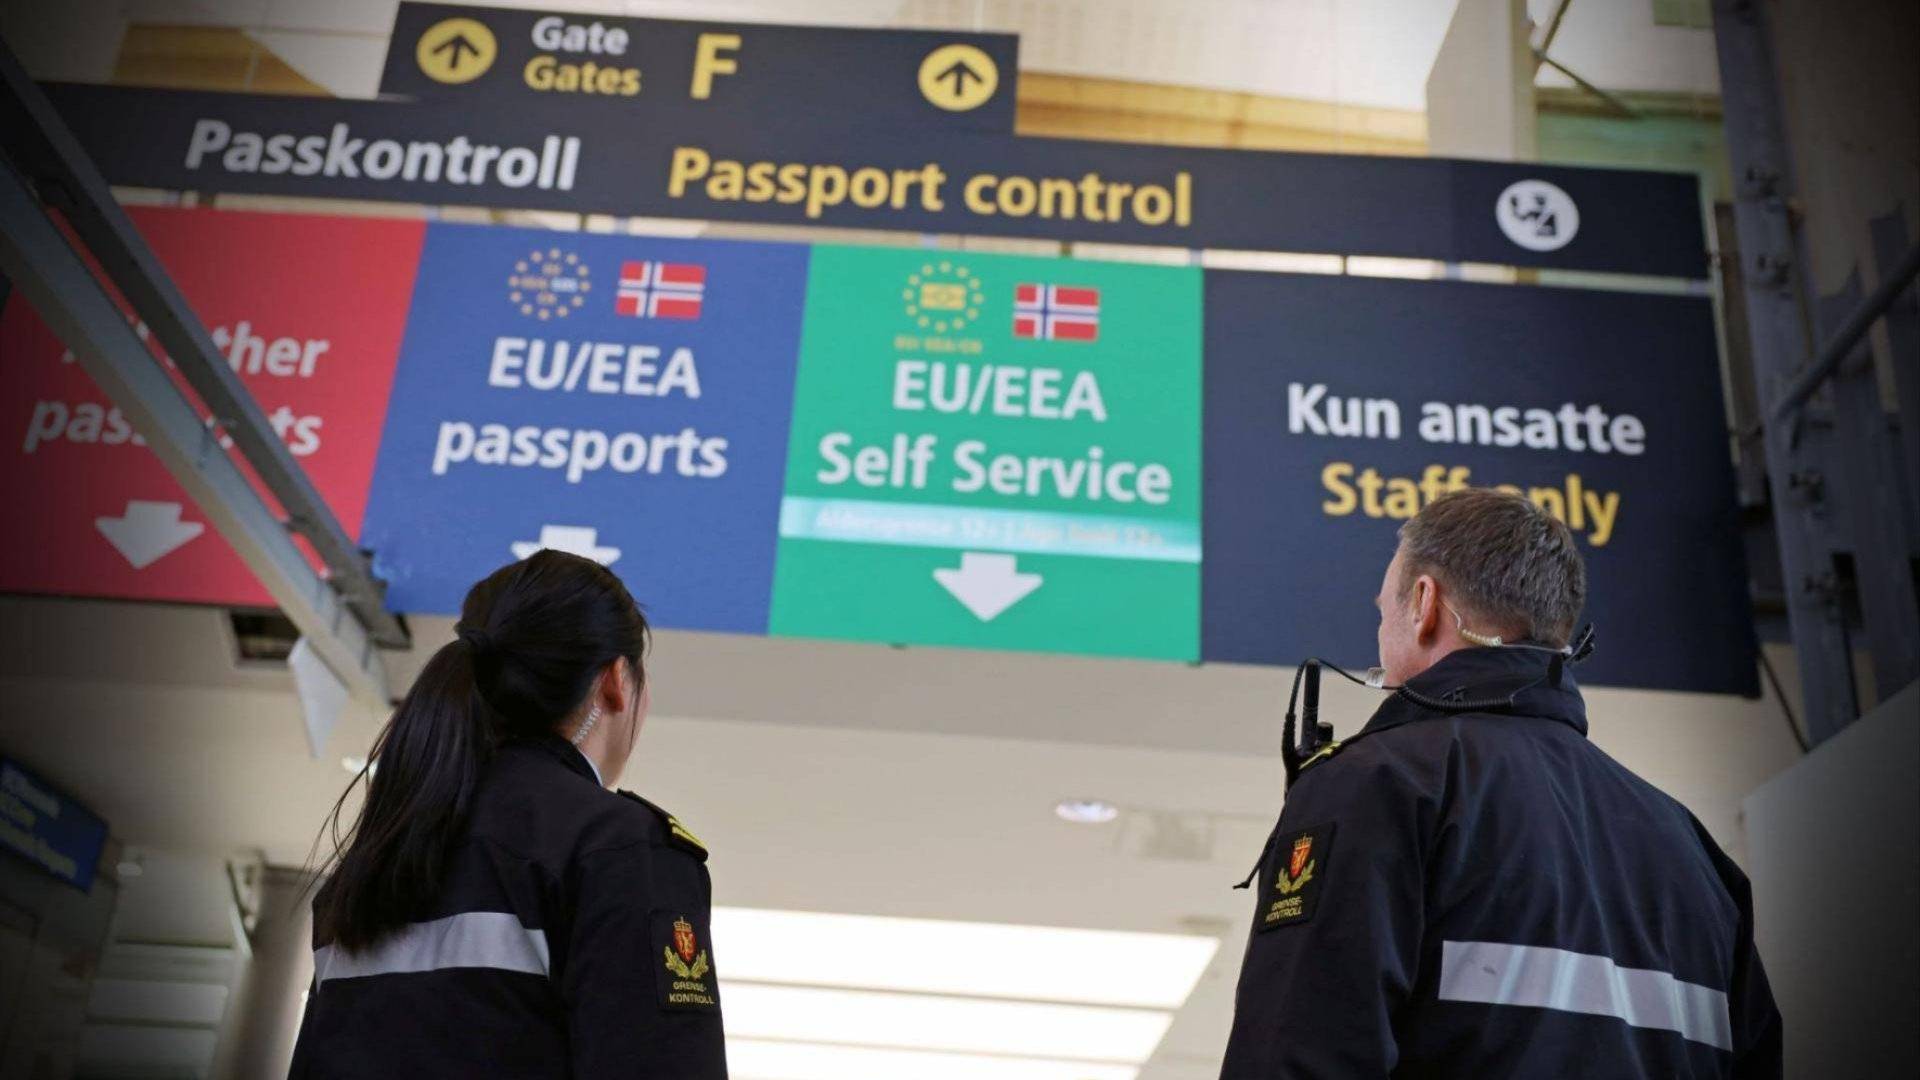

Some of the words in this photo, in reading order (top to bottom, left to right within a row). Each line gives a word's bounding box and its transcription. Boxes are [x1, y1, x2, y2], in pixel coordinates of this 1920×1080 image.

[531, 16, 628, 56] Gate
[690, 33, 741, 99] F
[523, 56, 641, 96] Gates
[185, 119, 580, 190] Passkontroll
[668, 146, 946, 218] Passport
[964, 172, 1192, 226] control
[489, 337, 701, 399] EU/EEA
[893, 360, 1107, 421] EU/EEA
[1288, 382, 1400, 439] Kun
[1419, 401, 1645, 455] ansatte
[432, 421, 728, 483] passports
[817, 433, 937, 489] Self
[952, 441, 1171, 504] Service
[1496, 474, 1619, 546] nly
[669, 993, 715, 1004] KONTROLL
